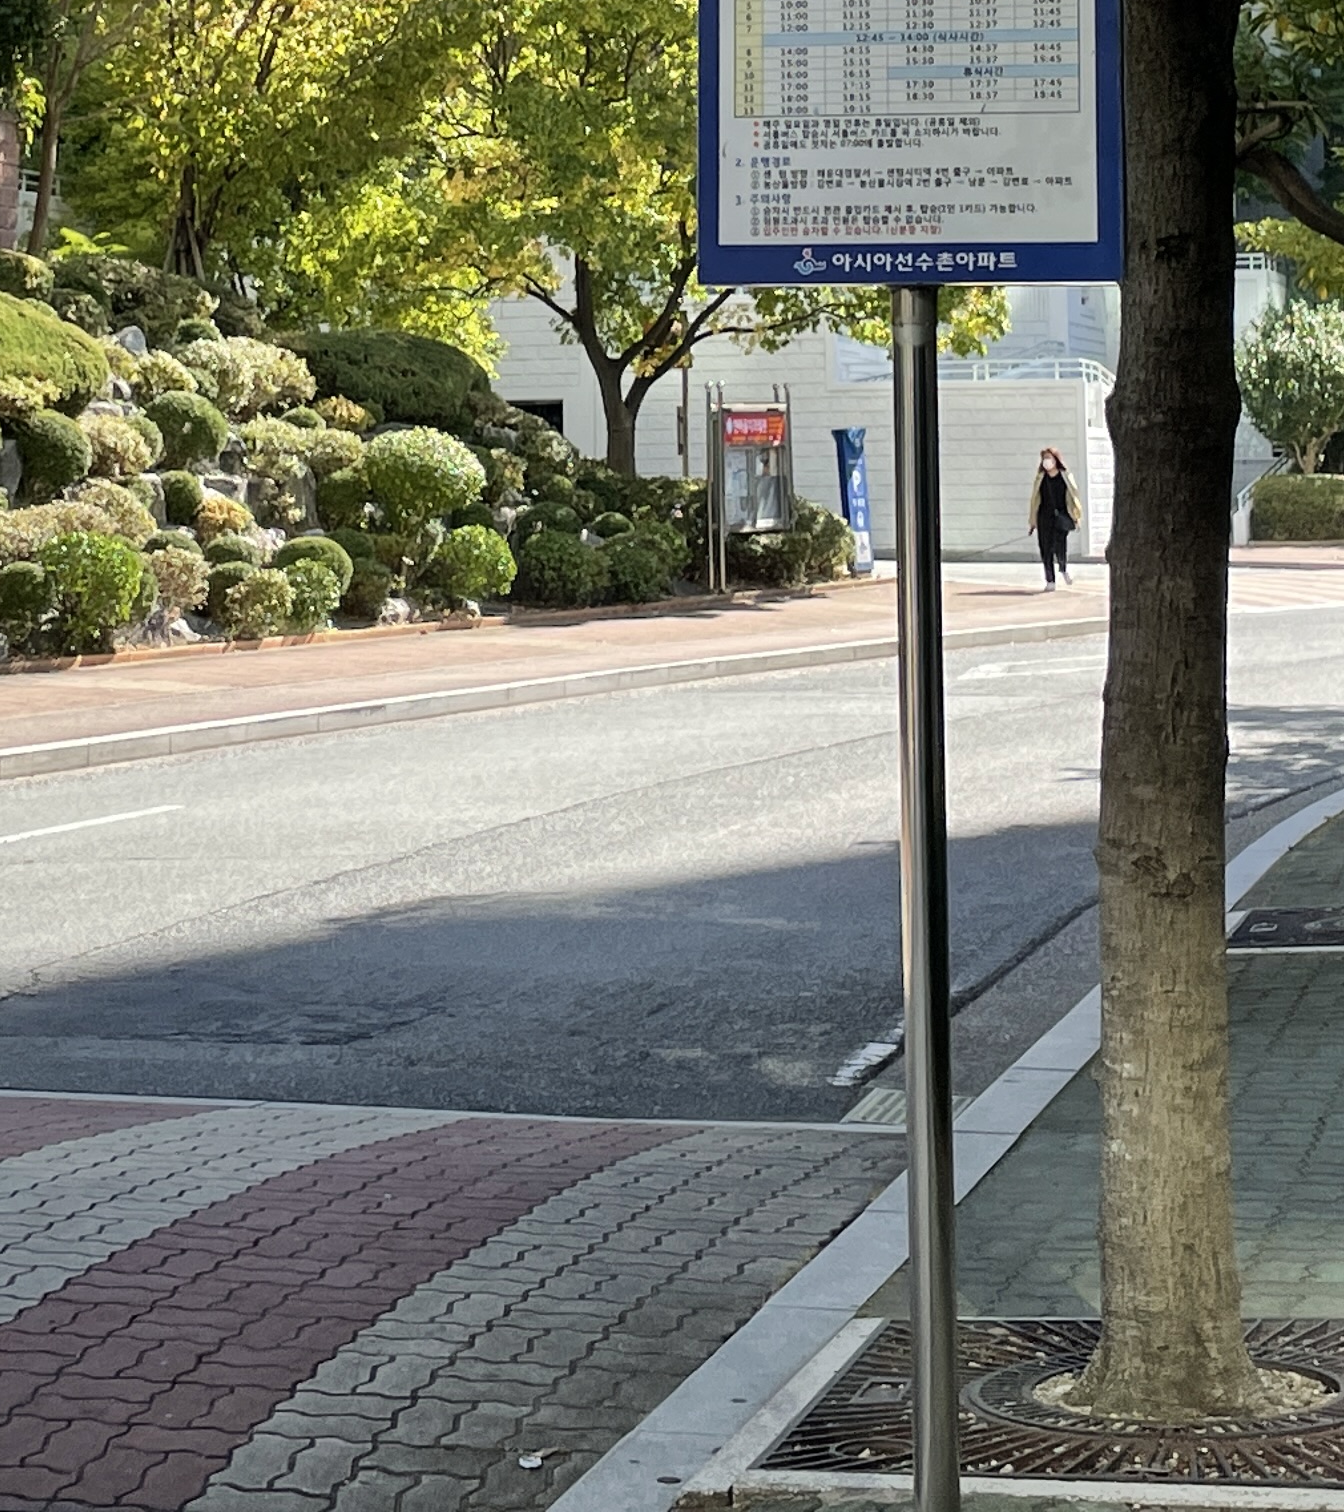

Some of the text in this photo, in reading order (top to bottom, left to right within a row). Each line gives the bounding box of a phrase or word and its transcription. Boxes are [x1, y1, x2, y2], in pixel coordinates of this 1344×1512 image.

[857, 33, 883, 42] 12:45
[901, 33, 929, 41] 14:00
[933, 32, 984, 42] (식사시간)
[832, 252, 1018, 272] 아시아선수촌아파트
